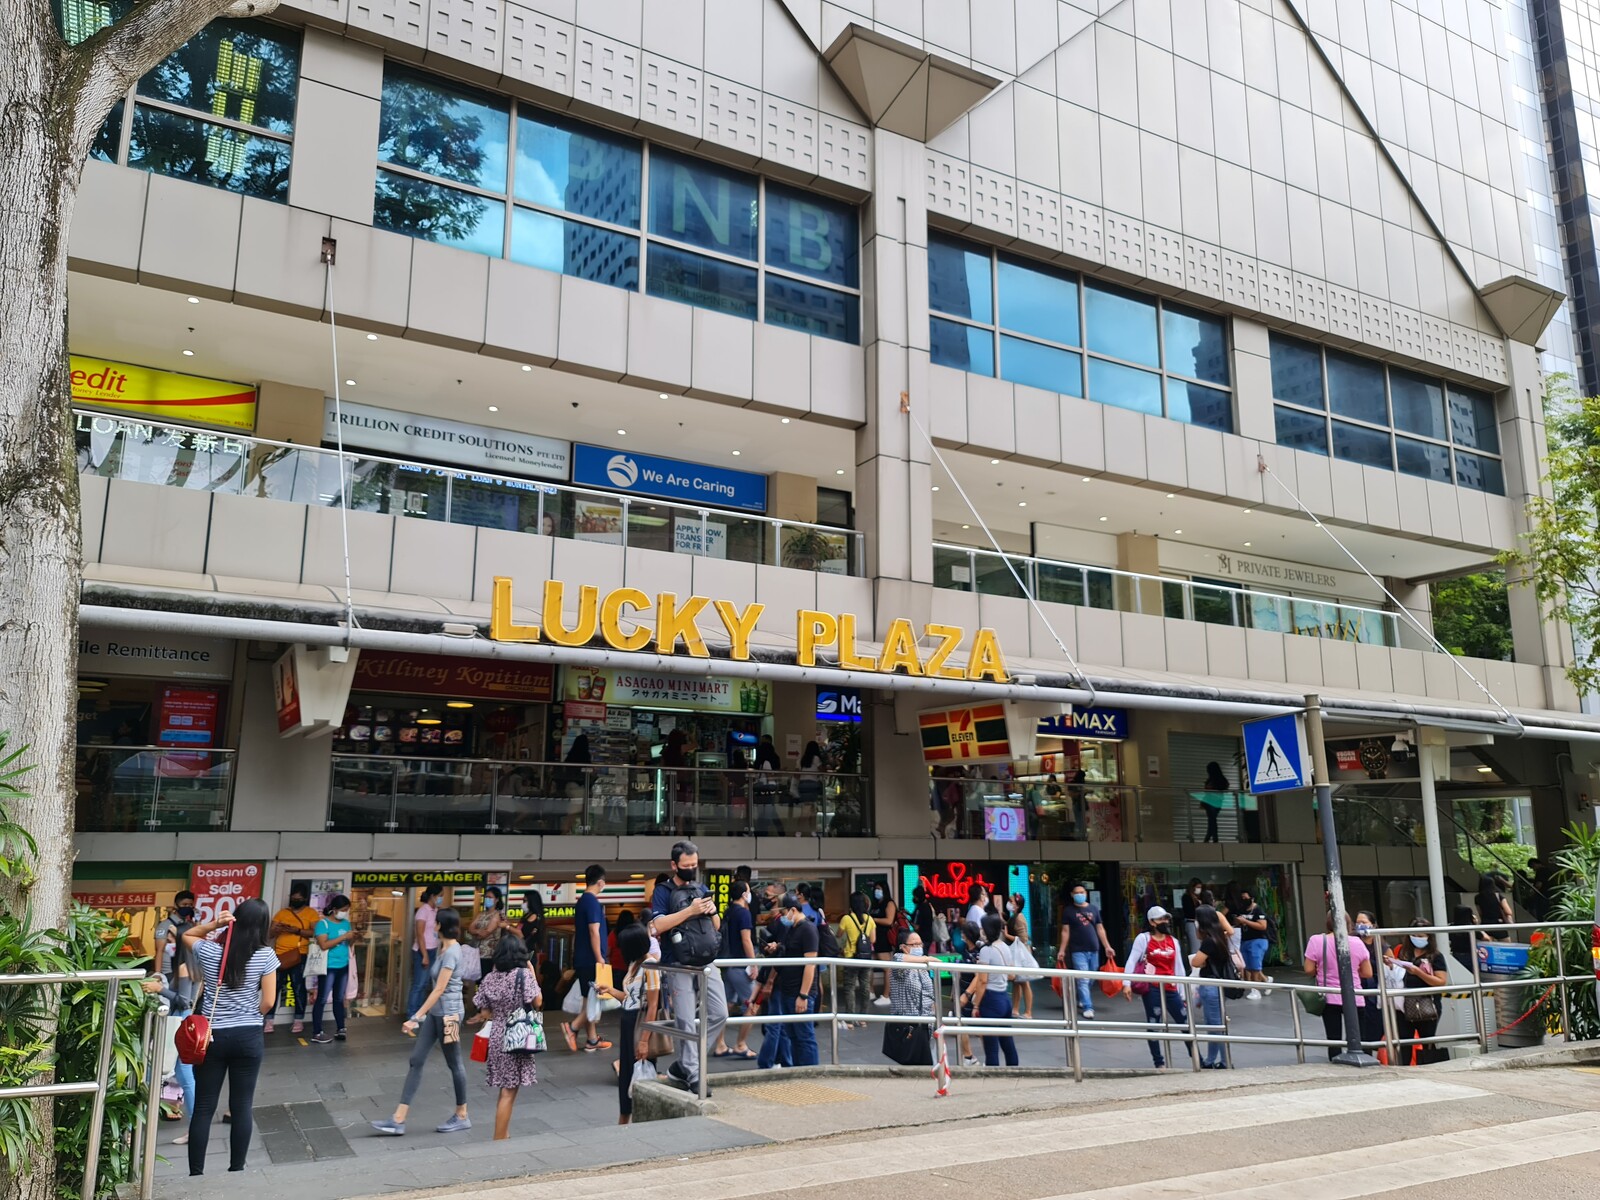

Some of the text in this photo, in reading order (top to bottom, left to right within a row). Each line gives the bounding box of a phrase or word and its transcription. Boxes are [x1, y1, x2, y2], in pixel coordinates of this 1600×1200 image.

[329, 411, 565, 461] TRILLION CREDIT SOLUTIONS PTE LTD
[485, 452, 563, 470] Licensed Moneylender
[642, 468, 735, 498] We Are Caring
[676, 524, 723, 538] APPLY OW,
[676, 532, 714, 544] TRANSER
[676, 541, 710, 552] FOR FRE
[1237, 560, 1281, 578] PRIVATE
[1283, 569, 1336, 587] JEWELERS
[490, 576, 1012, 683] LUCKY PLAZA
[107, 641, 210, 662] Remittance
[357, 658, 550, 689] Killiney Kopitiam
[616, 676, 729, 695] ASAGAO MINIMART
[632, 689, 717, 703] アサガオミニマート
[1073, 711, 1117, 731] MAX
[197, 866, 243, 878] bossini
[354, 873, 483, 882] MONEY CHANGER
[209, 881, 243, 895] sale
[98, 895, 124, 904] SALE
[127, 894, 153, 903] SALE
